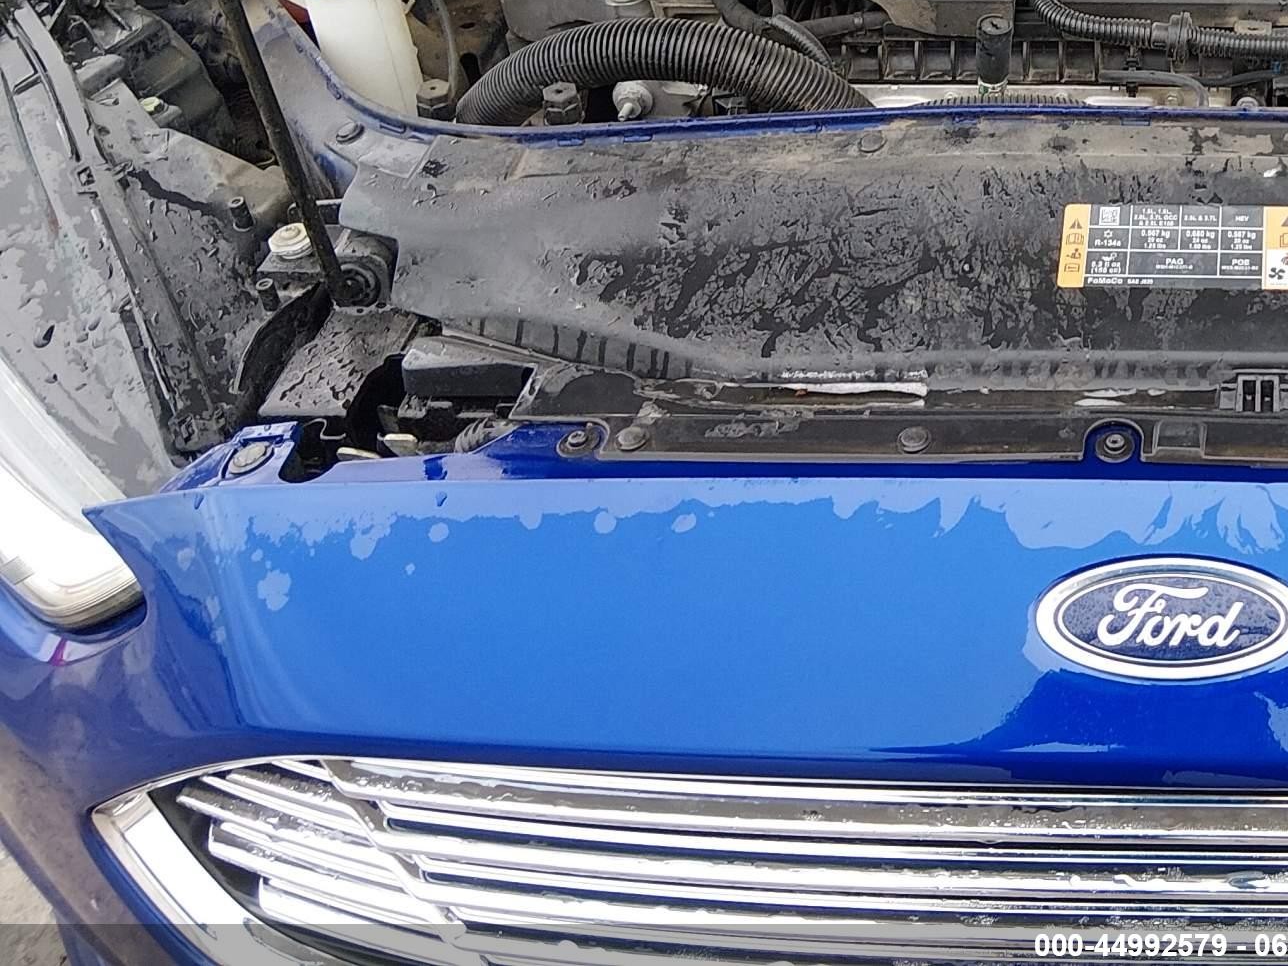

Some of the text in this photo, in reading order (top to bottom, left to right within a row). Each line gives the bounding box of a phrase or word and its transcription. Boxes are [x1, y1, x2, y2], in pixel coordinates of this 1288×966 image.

[1161, 230, 1170, 238] kg
[1247, 230, 1256, 239] kg
[1097, 583, 1244, 647] Ford
